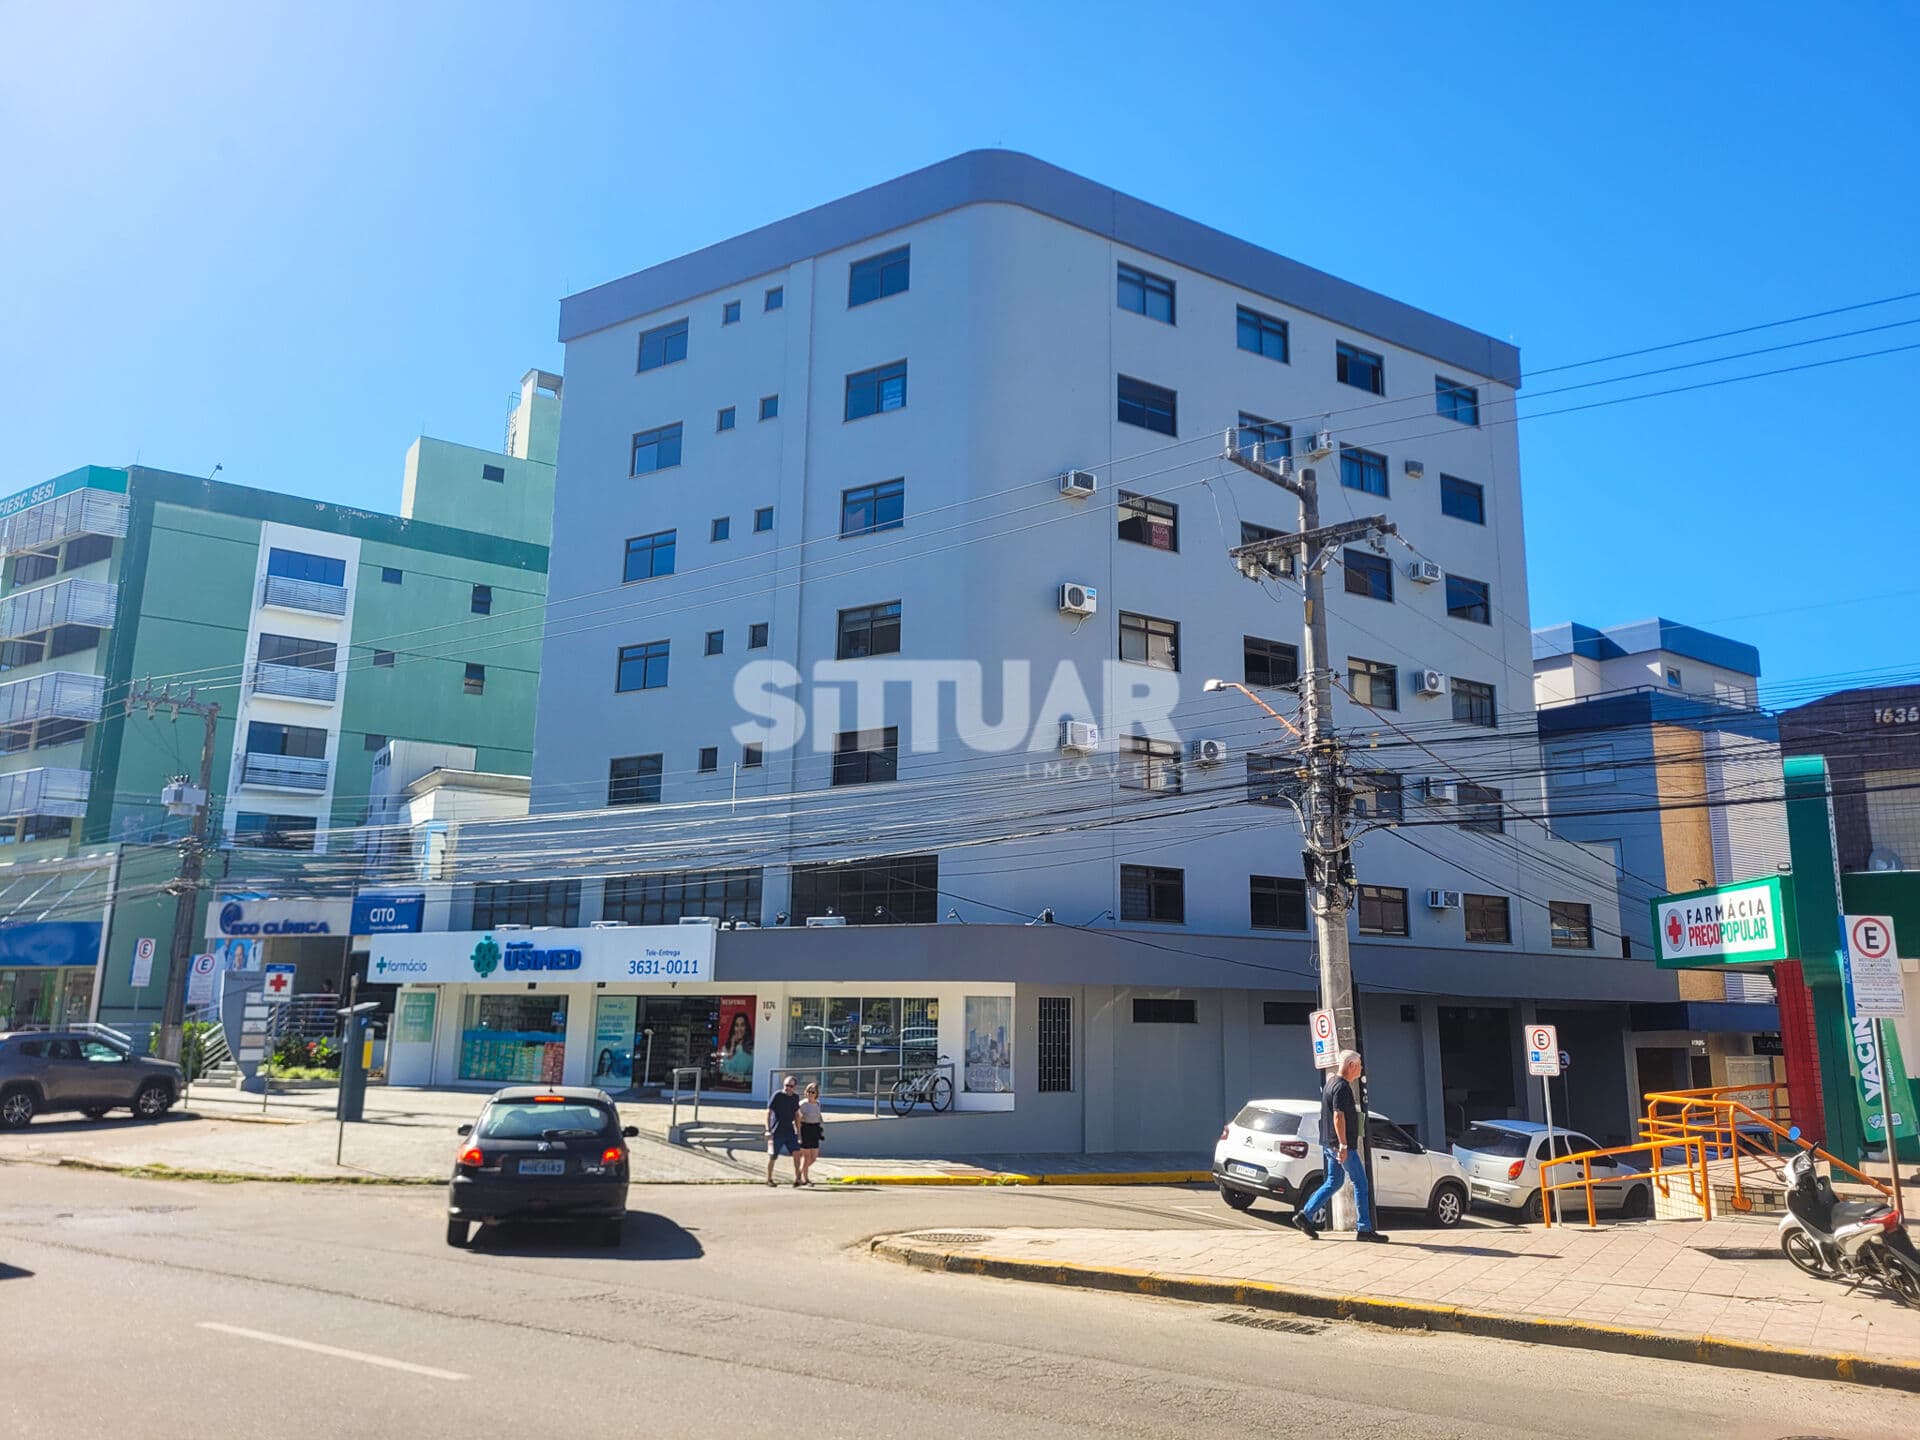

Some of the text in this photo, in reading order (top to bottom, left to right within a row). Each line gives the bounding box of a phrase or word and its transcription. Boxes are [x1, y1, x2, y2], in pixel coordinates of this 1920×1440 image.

[30, 481, 56, 503] SESI
[1874, 706, 1920, 724] 1636
[370, 907, 396, 923] CITO
[1686, 898, 1766, 925] FARMÁCIA
[1864, 926, 1880, 949] E
[142, 943, 150, 954] E
[200, 958, 210, 970] E
[504, 949, 582, 971] USIMED
[628, 959, 699, 975] 3631-0011
[1537, 1033, 1545, 1046] E
